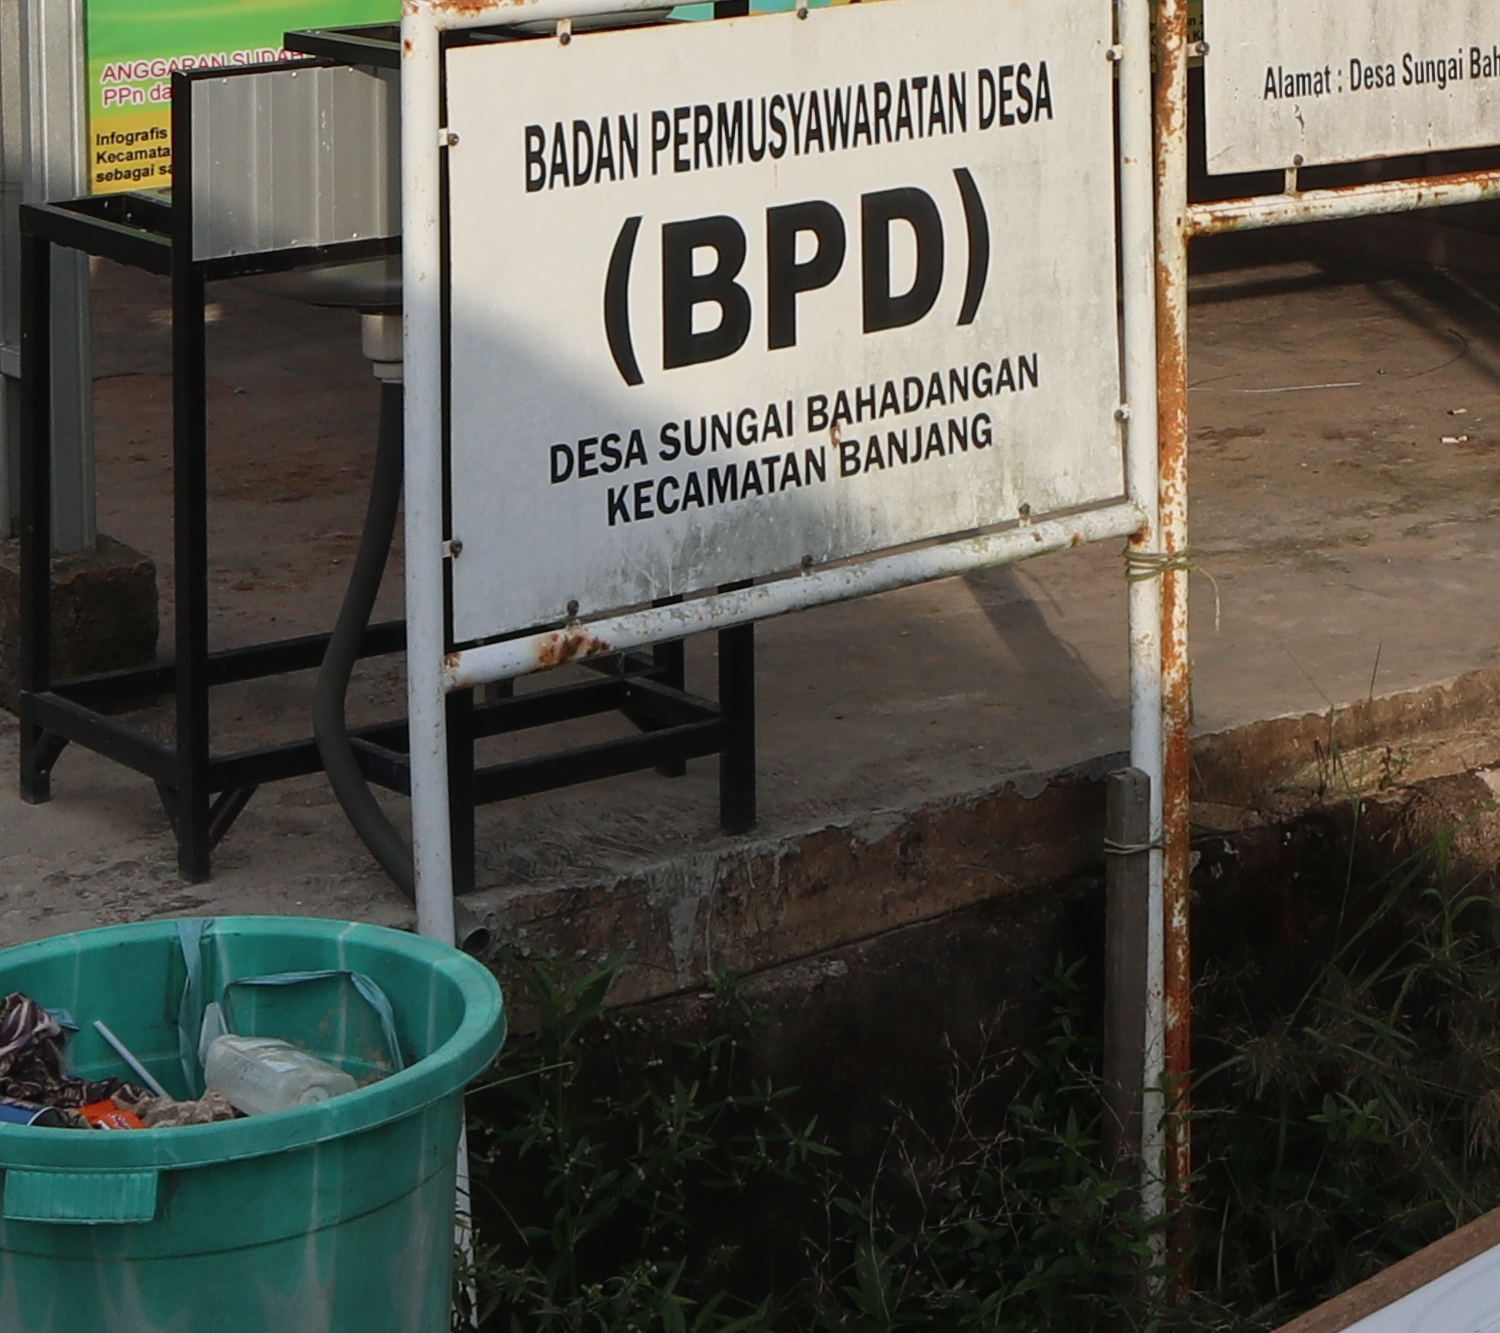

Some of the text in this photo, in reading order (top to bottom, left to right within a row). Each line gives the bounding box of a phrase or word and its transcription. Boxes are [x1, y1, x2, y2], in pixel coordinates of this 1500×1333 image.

[104, 86, 143, 106] PPn
[1263, 64, 1331, 101] Alamat
[1349, 59, 1396, 90] Desa
[1402, 52, 1464, 87] Sungai
[96, 126, 168, 146] Infografis
[523, 61, 1054, 193] BADAN PERMUSYAWARATAN DESA
[96, 165, 154, 183] sebagai
[603, 168, 990, 385] (BPD)
[549, 353, 1039, 485] DESA SUNGAI BAHADANGAN
[606, 413, 994, 527] KECAMATAN BANJANG
